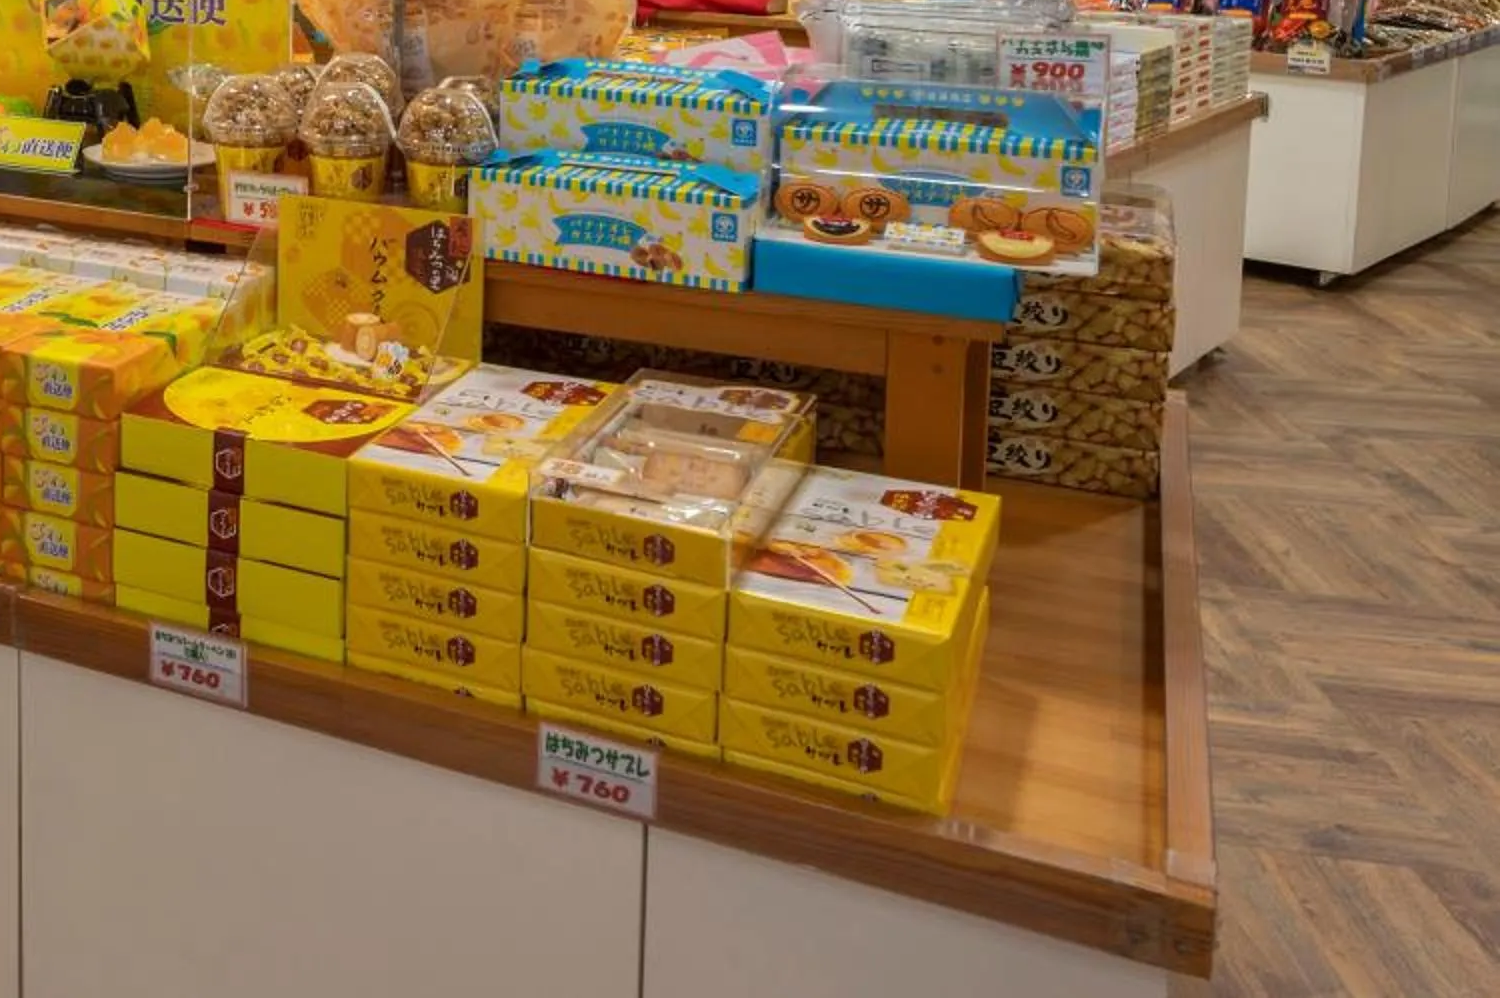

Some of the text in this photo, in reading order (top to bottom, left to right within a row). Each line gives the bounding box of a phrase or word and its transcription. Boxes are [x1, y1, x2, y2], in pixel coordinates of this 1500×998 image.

[1010, 61, 1085, 79] ¥900
[1011, 300, 1069, 327] 絞り
[160, 659, 221, 688] ¥760
[545, 730, 651, 777] はちみつサブレ
[551, 765, 631, 804] ¥760
